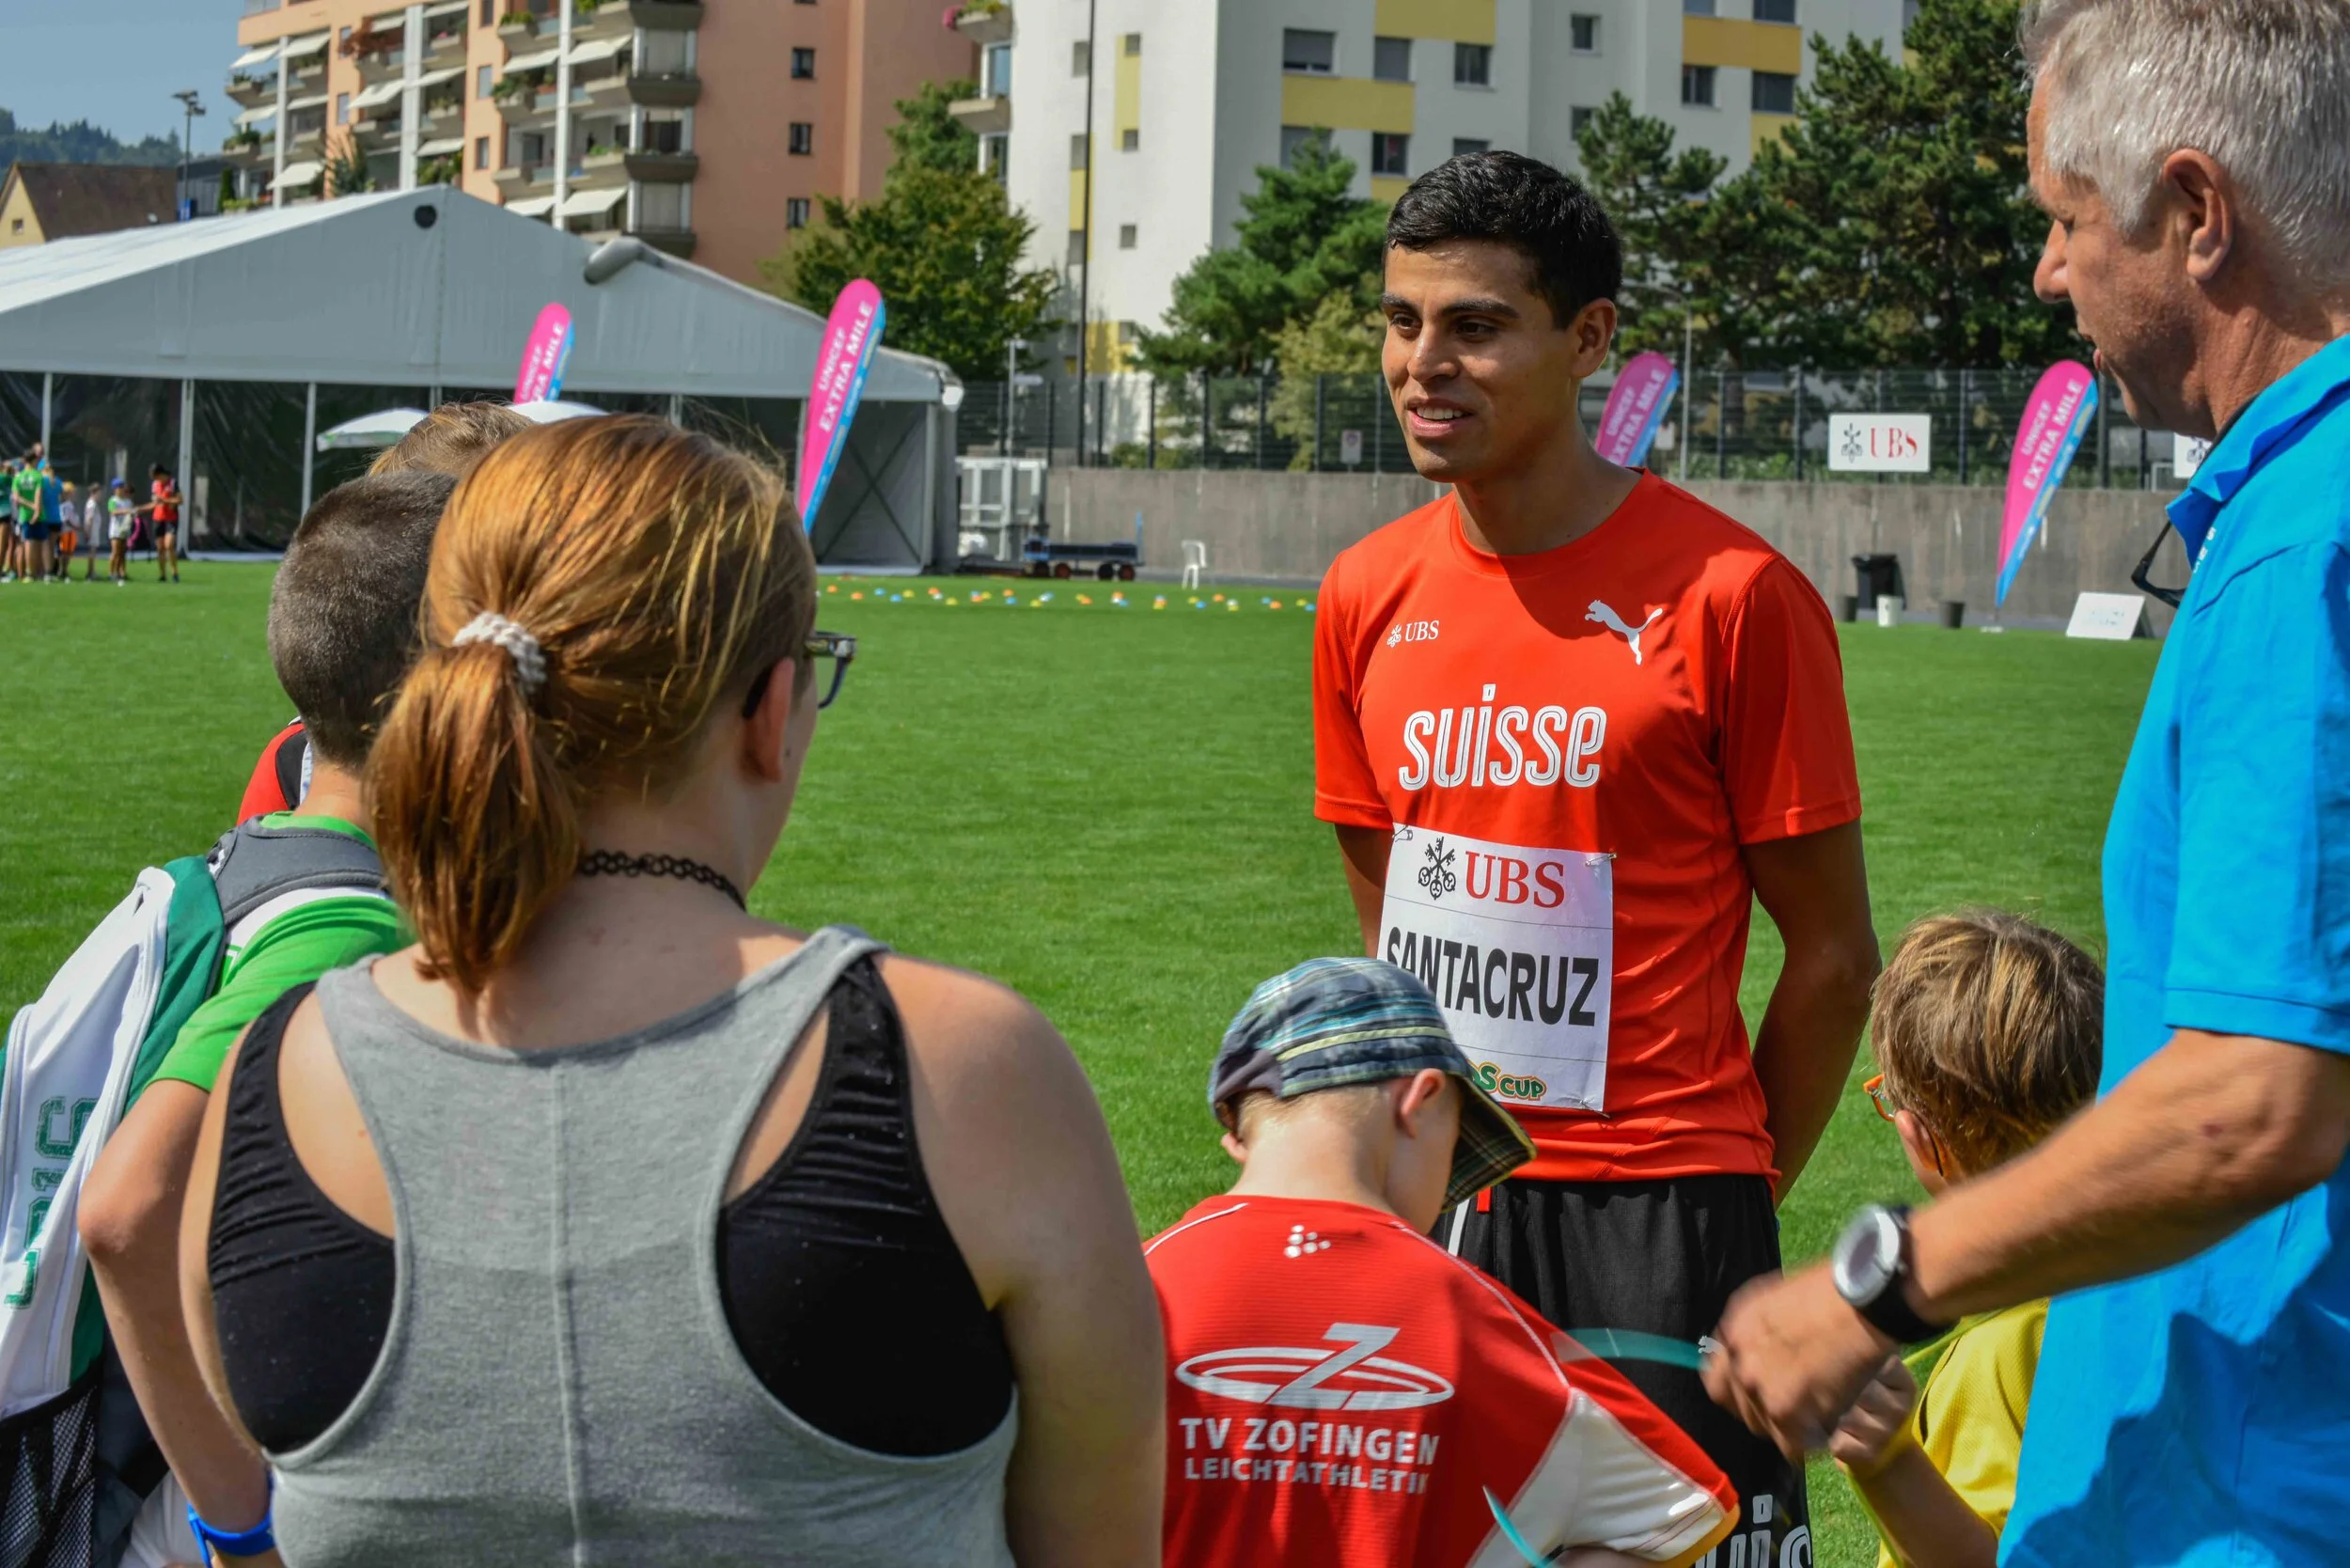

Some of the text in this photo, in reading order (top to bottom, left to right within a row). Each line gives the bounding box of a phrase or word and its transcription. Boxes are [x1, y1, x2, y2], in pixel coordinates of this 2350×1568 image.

[817, 326, 846, 391] UNICEF
[819, 360, 854, 432] EXTRA
[847, 300, 873, 356] MILE
[1636, 368, 1666, 411] MILE
[1870, 427, 1919, 459] UBS
[2021, 399, 2052, 456] UNICEF
[2022, 429, 2060, 491] EXTRA
[2052, 378, 2083, 426] MILE
[1404, 619, 1440, 643] UBS
[1398, 683, 1607, 792] suisse
[1465, 850, 1565, 909] UBS
[1386, 926, 1600, 1027] SANTACRUZ
[1498, 1075, 1545, 1099] CUP
[1179, 1418, 1440, 1466] TV ZOFINGEN
